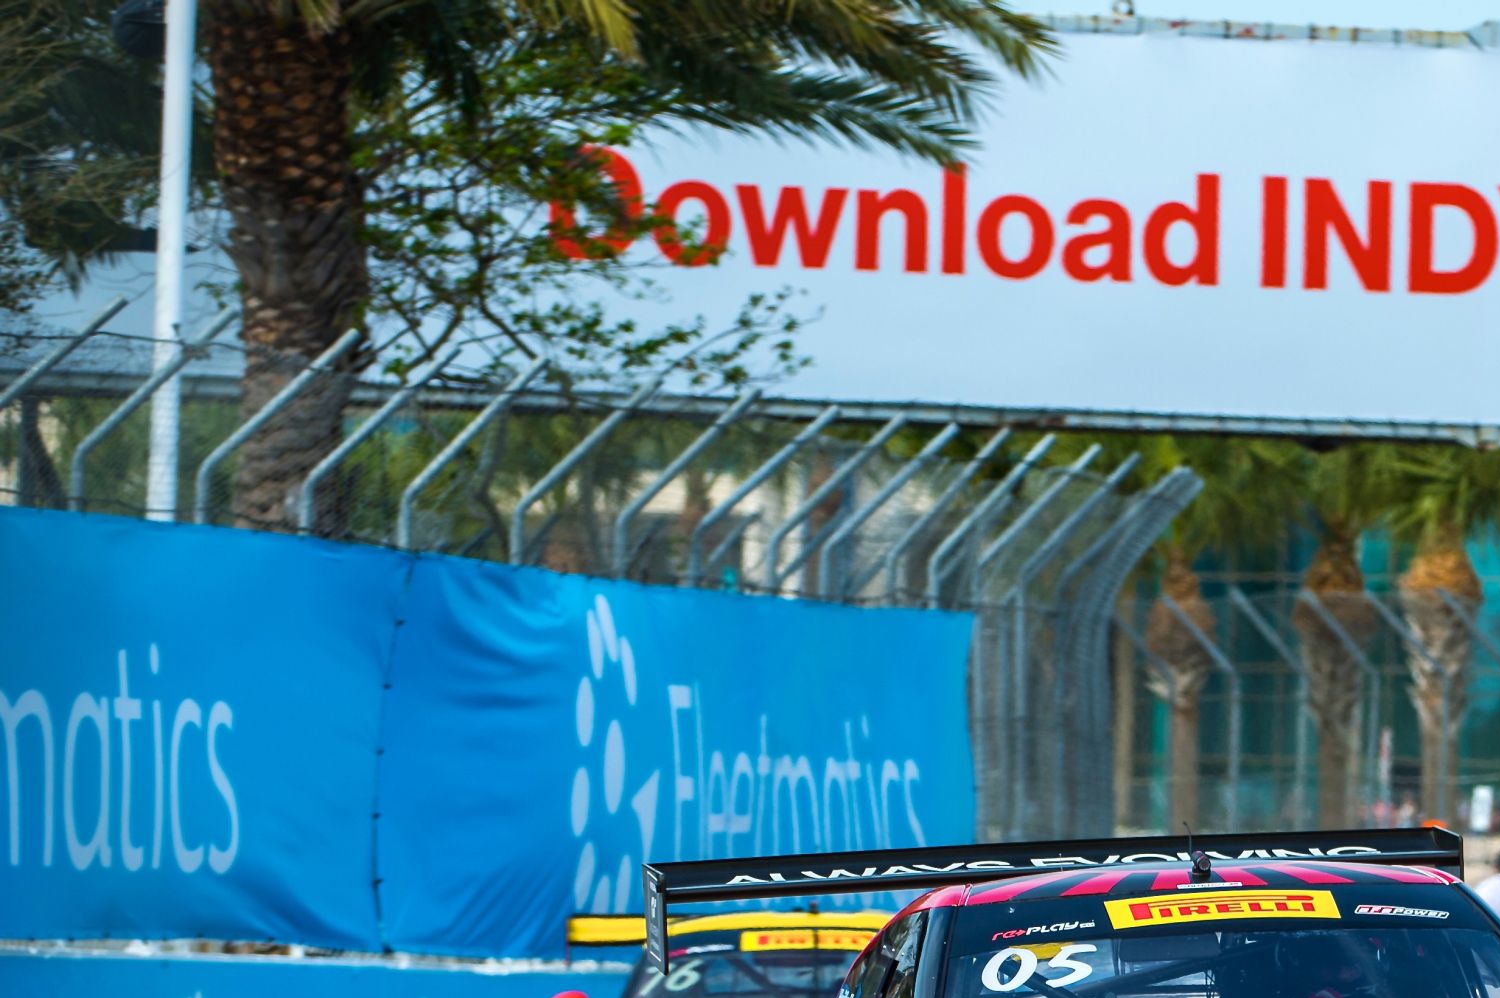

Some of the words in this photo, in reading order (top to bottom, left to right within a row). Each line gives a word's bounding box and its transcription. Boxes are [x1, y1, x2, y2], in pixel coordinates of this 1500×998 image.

[548, 143, 1219, 287] Download
[1128, 894, 1316, 921] PIRELLI
[981, 944, 1097, 992] 05
